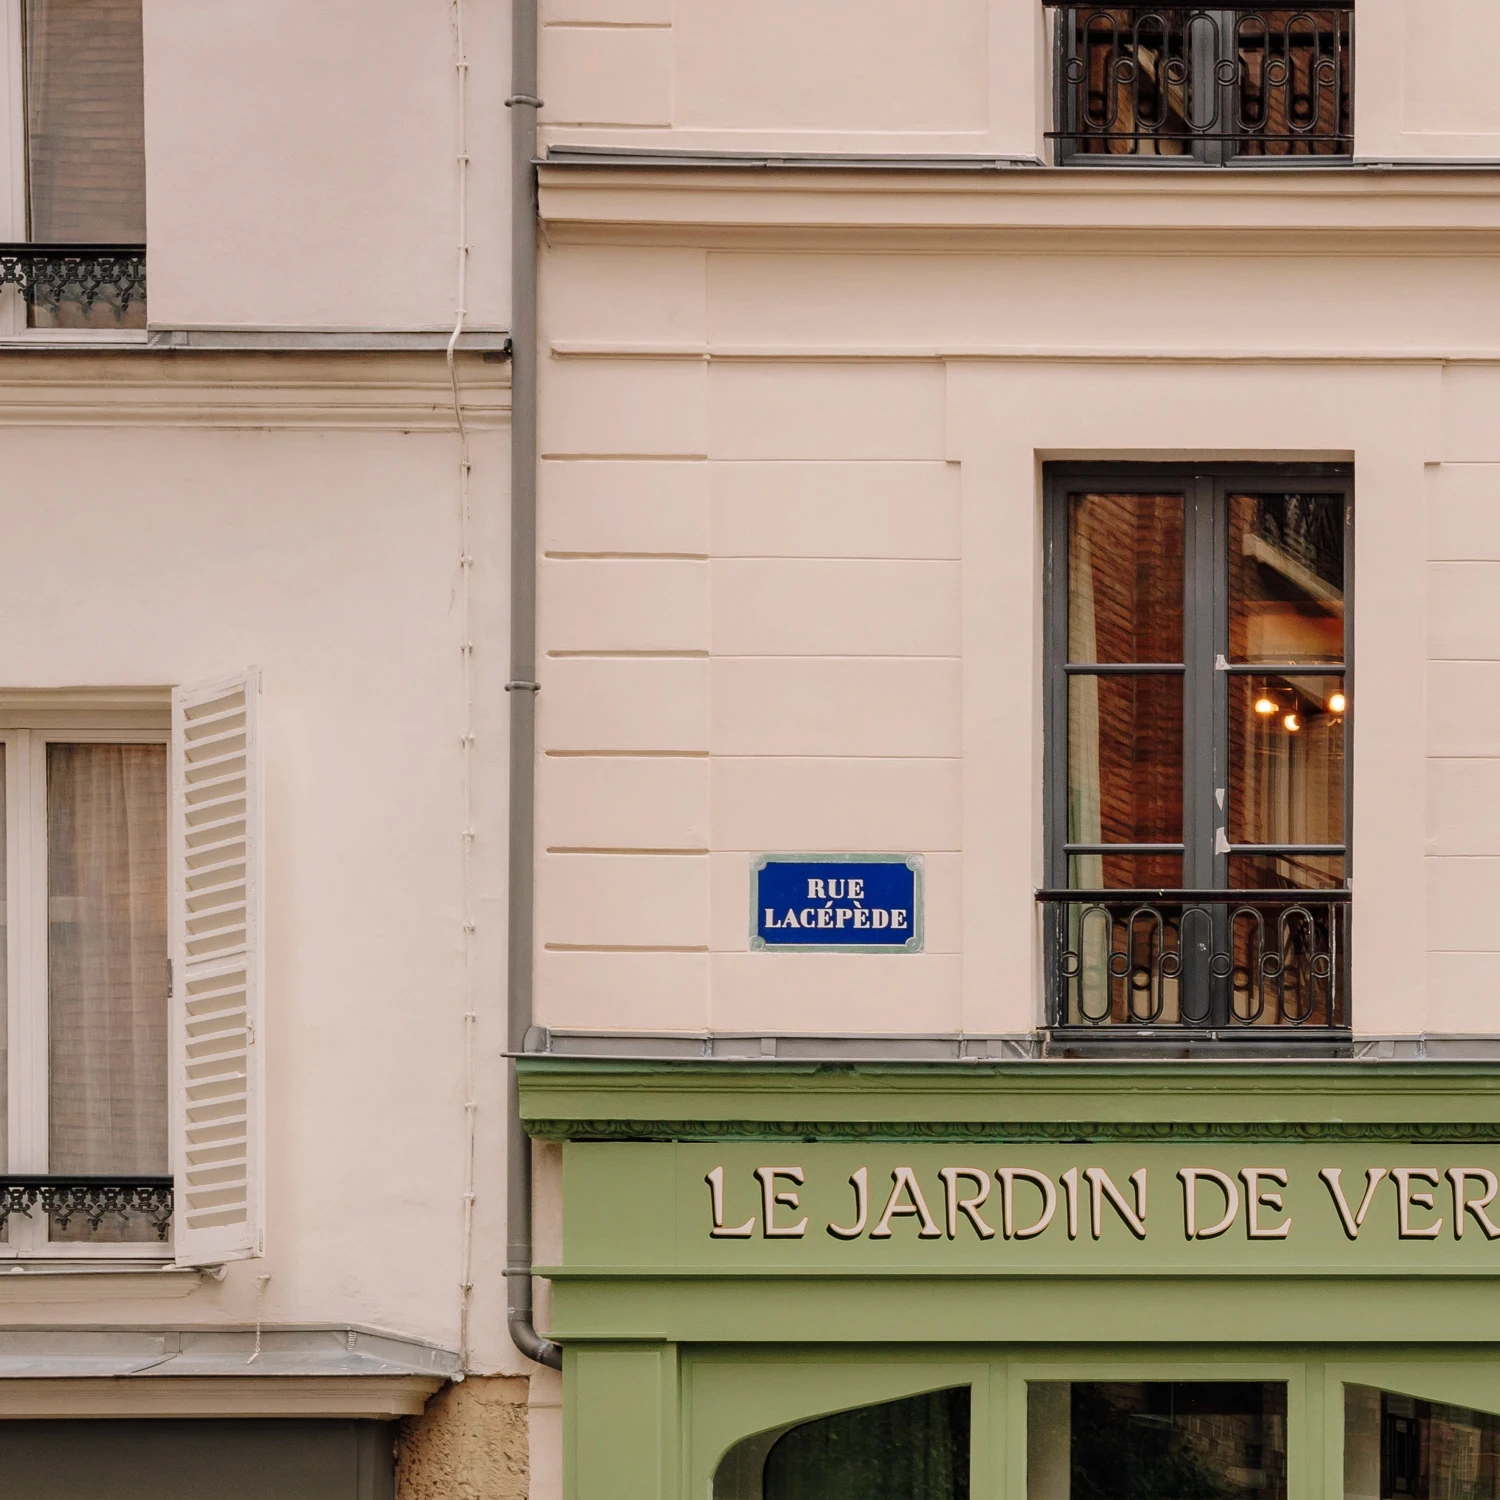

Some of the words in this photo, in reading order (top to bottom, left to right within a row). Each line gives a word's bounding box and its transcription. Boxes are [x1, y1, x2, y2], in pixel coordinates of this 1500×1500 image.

[807, 878, 864, 899] RUE
[764, 900, 907, 929] LACÉPÈDE
[704, 1165, 808, 1240] LE
[826, 1165, 1147, 1241] JARDIN
[1178, 1166, 1292, 1241] DE
